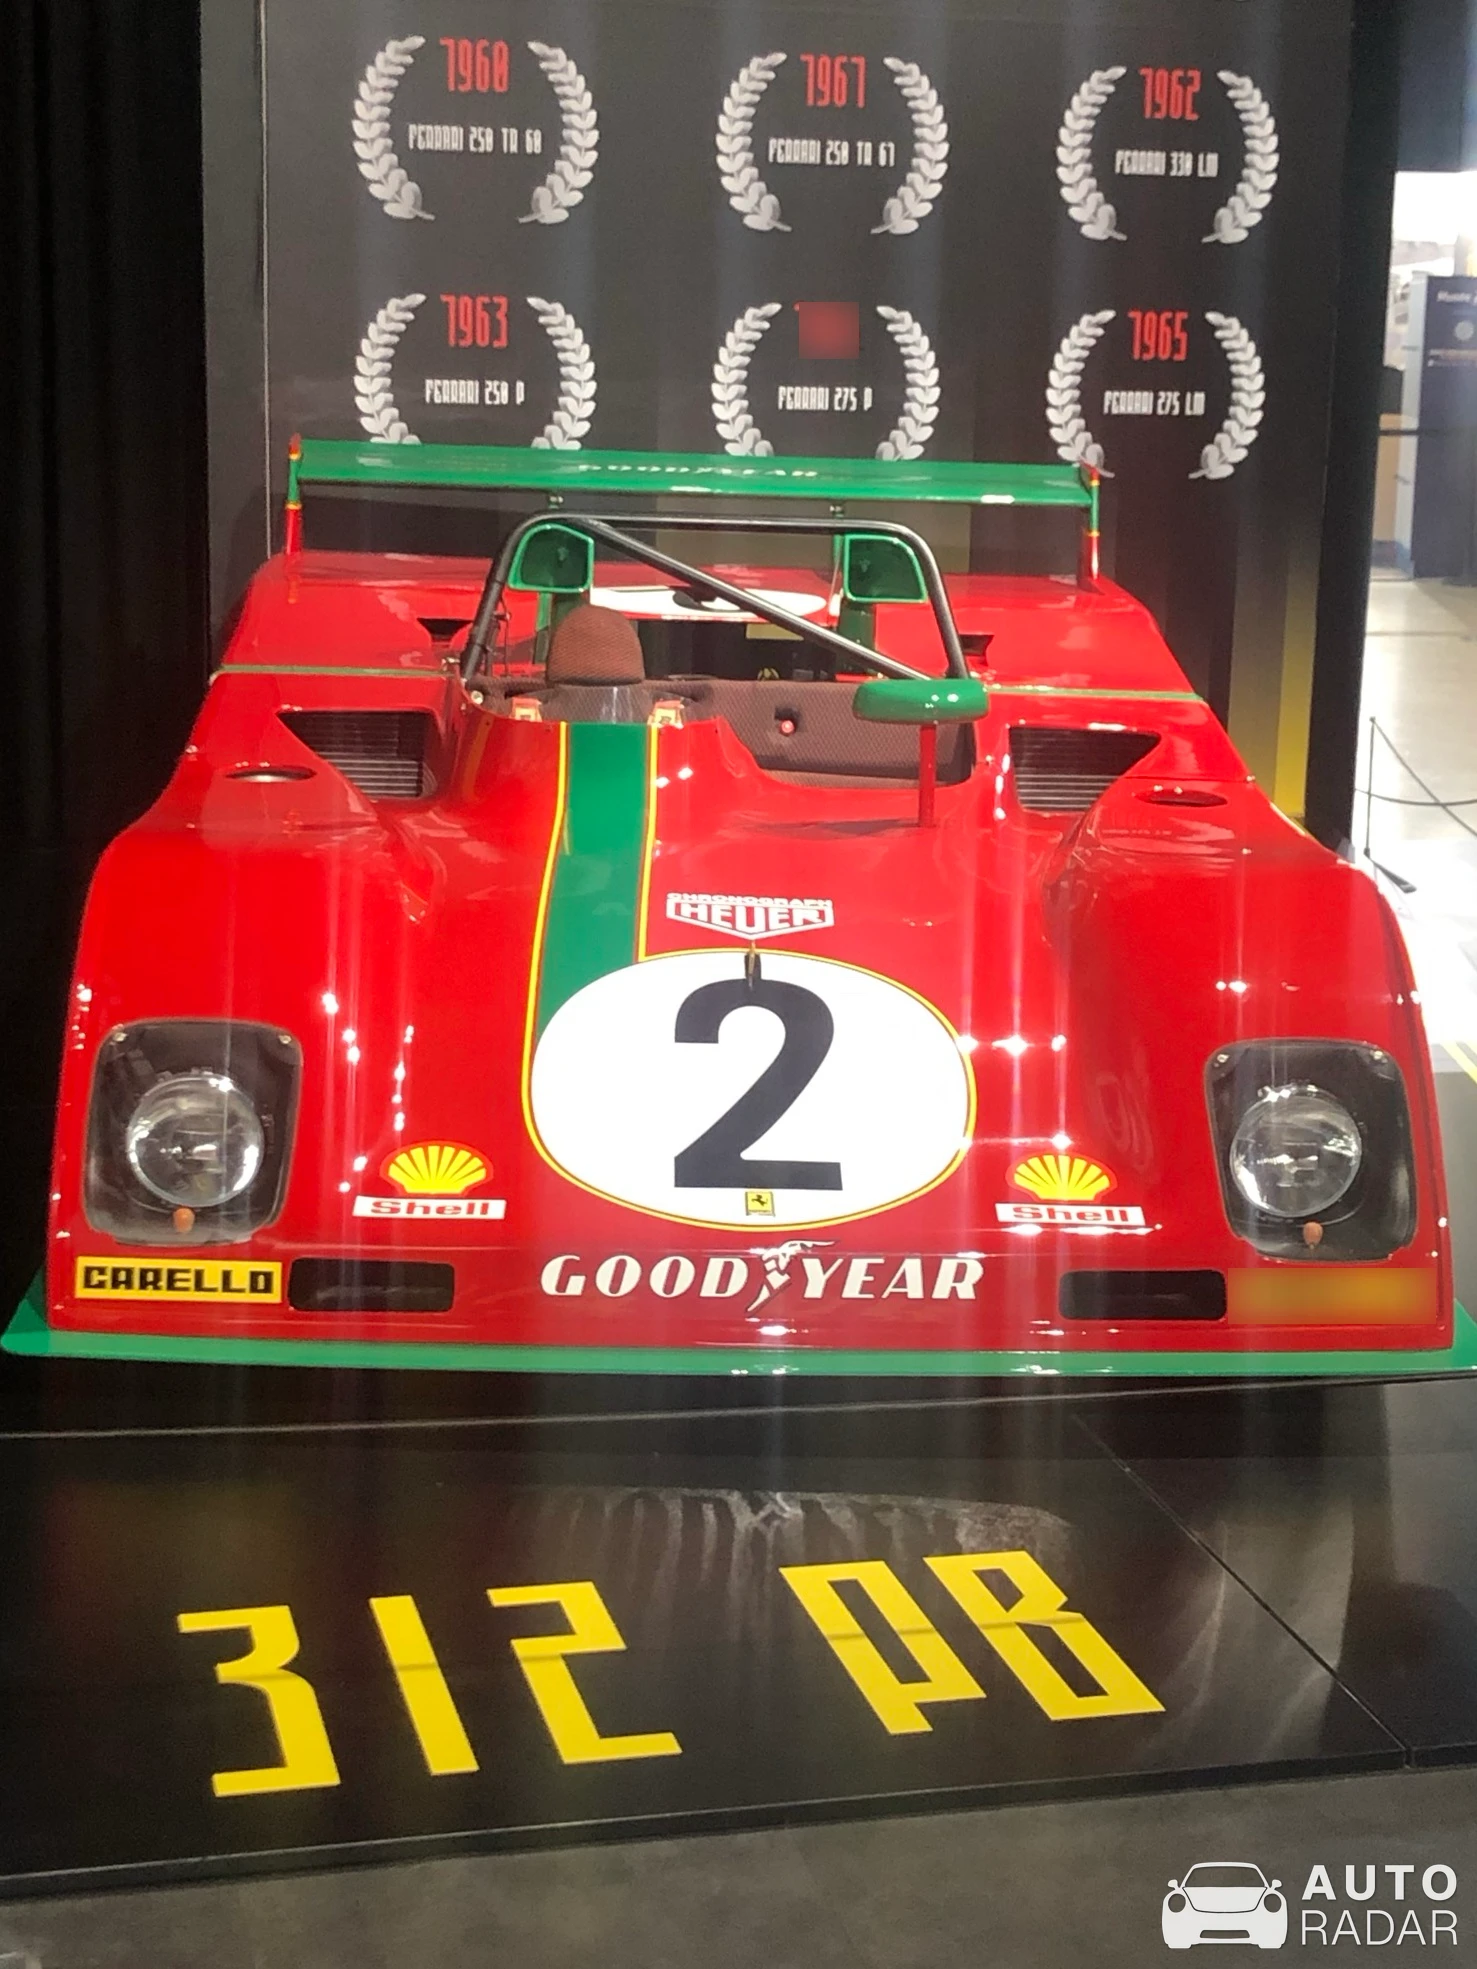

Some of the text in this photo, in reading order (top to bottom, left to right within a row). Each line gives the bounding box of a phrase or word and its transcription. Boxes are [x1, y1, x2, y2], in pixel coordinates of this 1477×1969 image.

[439, 36, 510, 93] 1960
[800, 53, 866, 108] 1961
[1138, 66, 1202, 120] 1962
[408, 124, 542, 154] FERRARI 250 TR 60
[768, 137, 895, 168] FERRARI 250 TR 61
[1115, 149, 1219, 178] FERRARI 330 LM
[440, 294, 508, 349] 1963
[1128, 309, 1189, 361] 1965
[425, 379, 525, 406] FERRARI 250 P
[778, 386, 873, 412] FERRARI 275 P
[1103, 390, 1206, 416] FERRARI 275 LM
[679, 902, 824, 933] HEUER
[673, 978, 844, 1191] 2
[371, 1200, 490, 1216] Shell
[1012, 1206, 1129, 1223] Shell
[83, 1265, 275, 1294] CARELLO
[177, 1550, 1166, 1797] 312 PB
